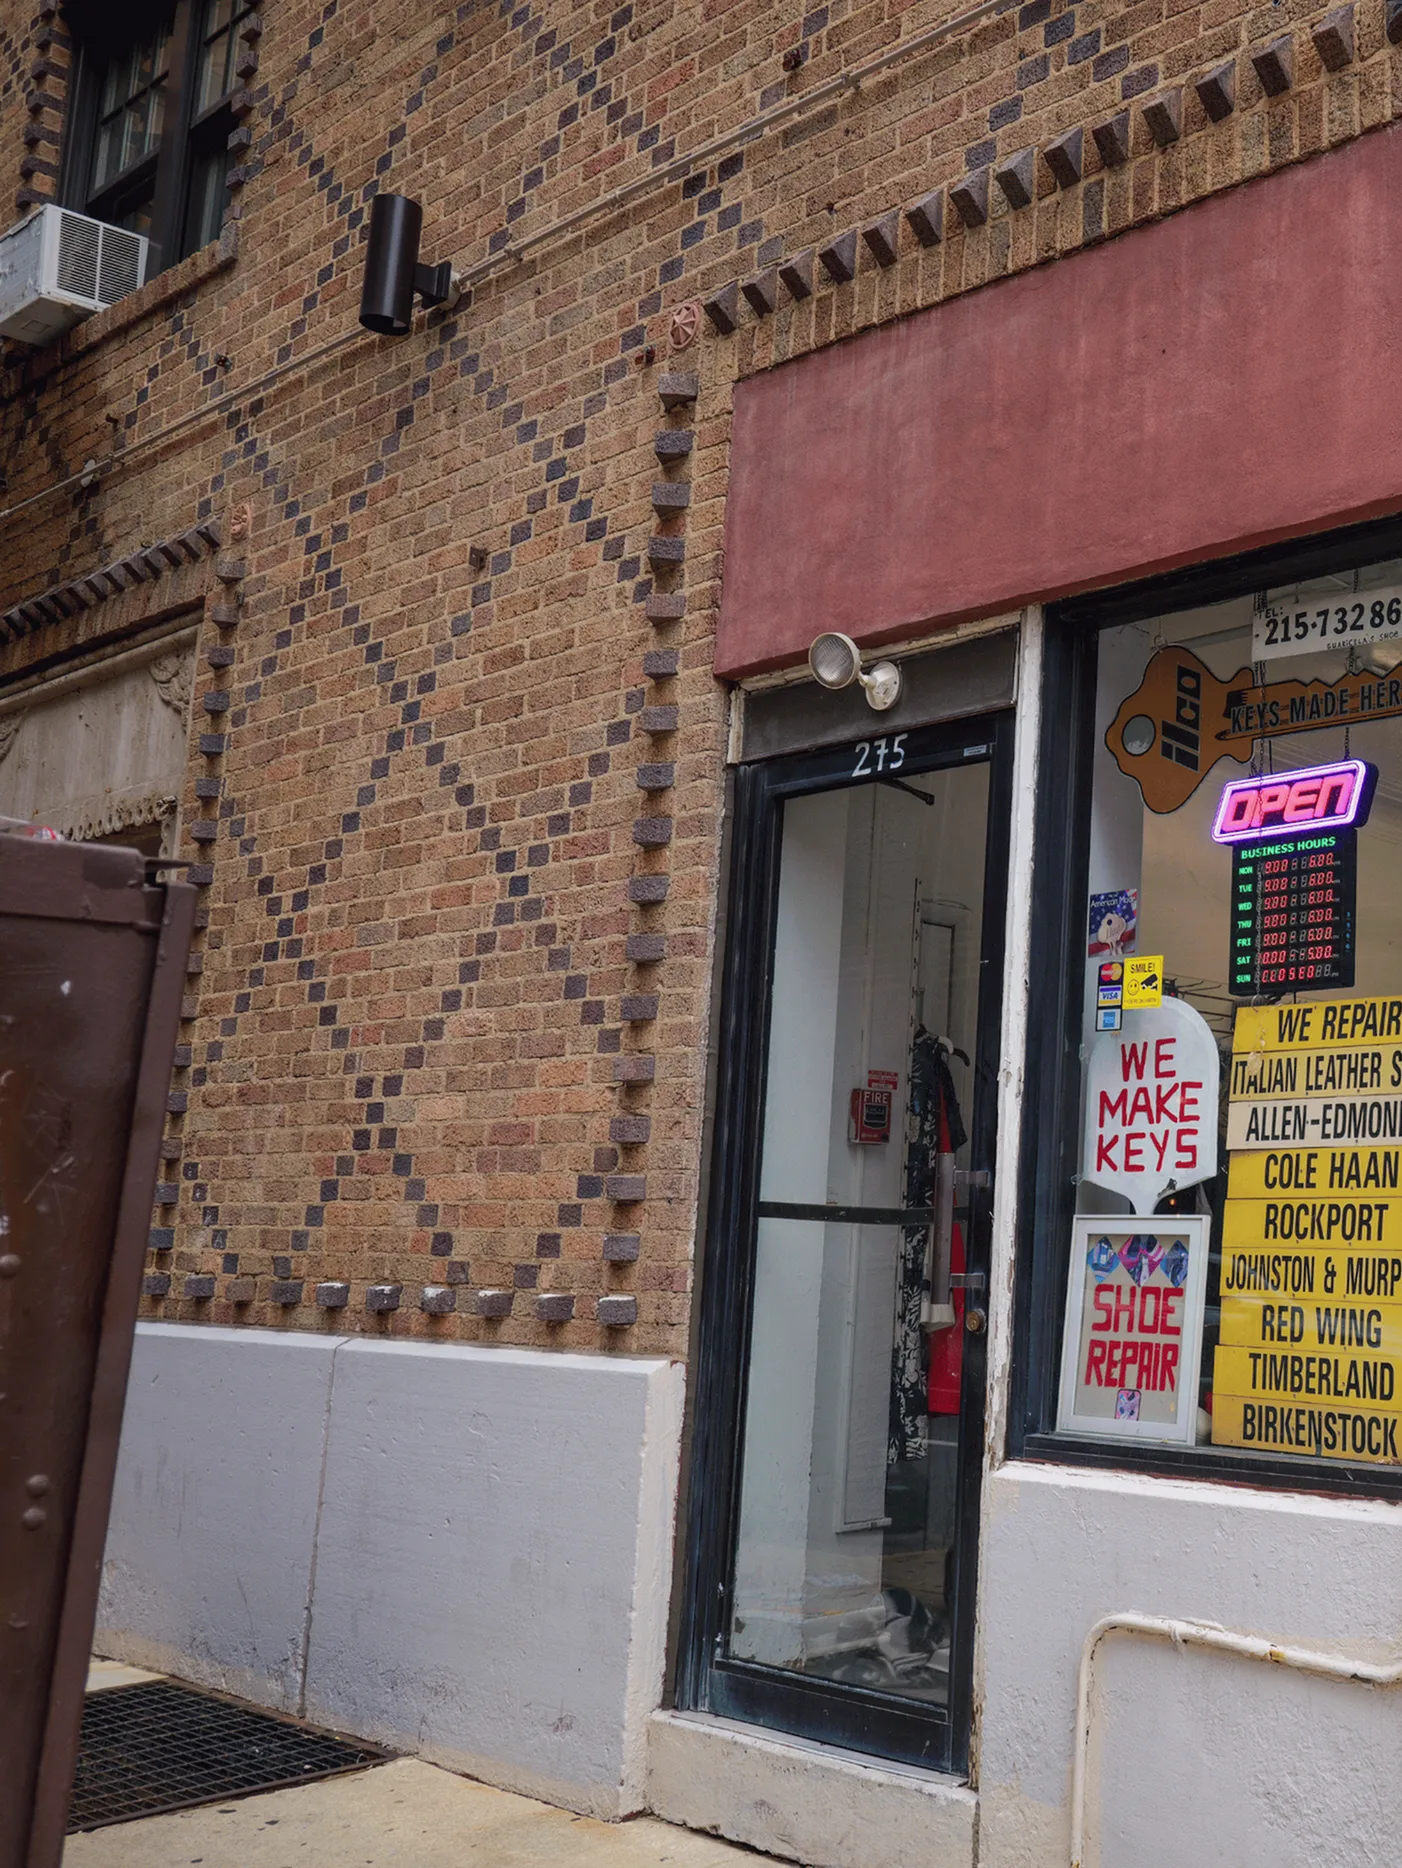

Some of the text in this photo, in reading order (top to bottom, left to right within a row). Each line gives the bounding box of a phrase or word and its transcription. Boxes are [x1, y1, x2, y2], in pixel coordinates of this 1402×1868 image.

[1258, 607, 1284, 620] TEL:
[1230, 699, 1282, 734] KEYS
[1289, 687, 1350, 725] MADE
[851, 733, 908, 777] 275
[1220, 771, 1356, 833] OPEN
[1241, 836, 1337, 860] BUSINESS HOURS
[1238, 866, 1253, 875] MON
[1238, 884, 1253, 893] TUE
[1236, 938, 1251, 947] FRI
[1237, 920, 1252, 929] THU
[1236, 955, 1251, 965] SAT
[1236, 974, 1251, 983] SUN
[1102, 991, 1119, 1000] VISA
[1278, 1000, 1402, 1044] WE REPAIR
[1120, 1037, 1178, 1082] WE
[1232, 1056, 1298, 1096] ITALIAN
[1305, 1051, 1382, 1092] LEATHER
[863, 1090, 889, 1104] FIRE
[1098, 1081, 1204, 1129] MAKE
[1096, 1128, 1198, 1173] KEYS
[1263, 1151, 1400, 1191] COLE HAAN
[1263, 1202, 1390, 1242] ROCKPORT
[1225, 1255, 1315, 1294] JOHNSTON
[1323, 1255, 1337, 1293] &
[1091, 1283, 1184, 1336] SHOE
[1261, 1304, 1383, 1349] RED WING
[1084, 1338, 1180, 1393] REPAIR
[1248, 1352, 1396, 1402] TIMBERLAND
[1241, 1403, 1398, 1459] BIRKENSTOCK
